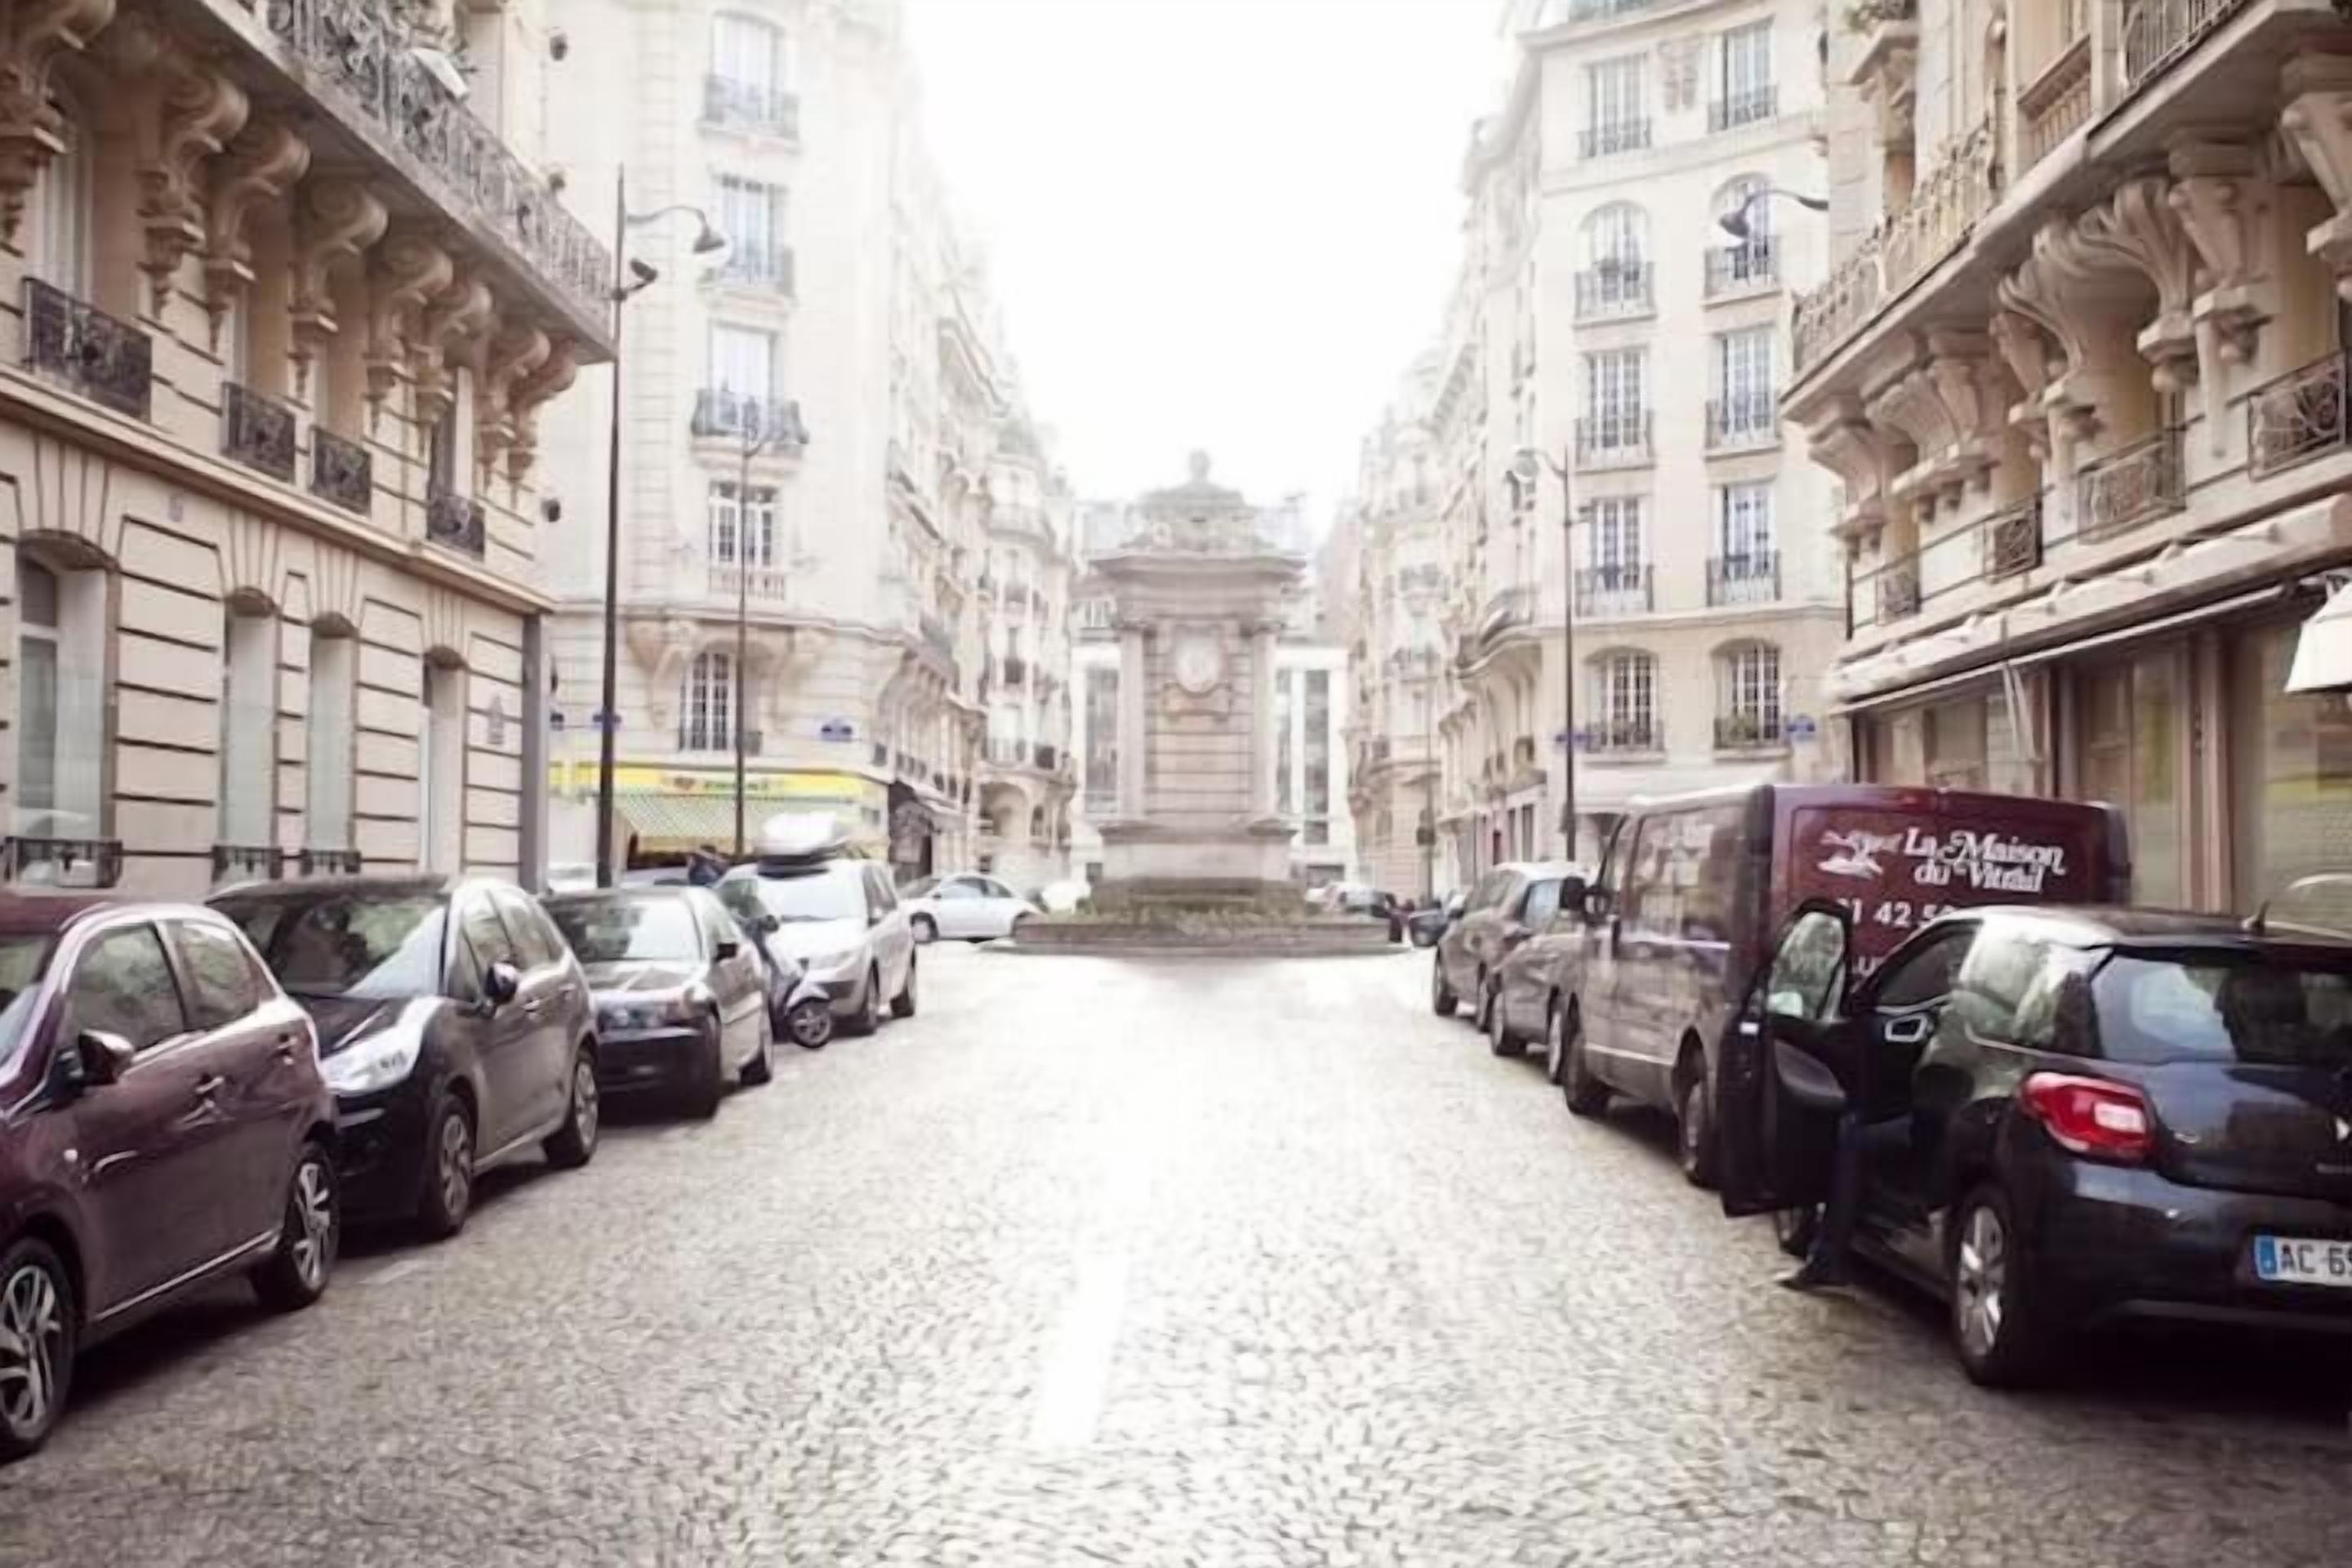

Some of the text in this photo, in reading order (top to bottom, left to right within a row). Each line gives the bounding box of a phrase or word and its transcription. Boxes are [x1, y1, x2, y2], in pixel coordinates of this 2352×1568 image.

[1904, 826, 2066, 876] La Maison
[1913, 858, 1951, 886] du
[1873, 902, 1912, 929] 42
[2328, 1246, 2352, 1277] 6
